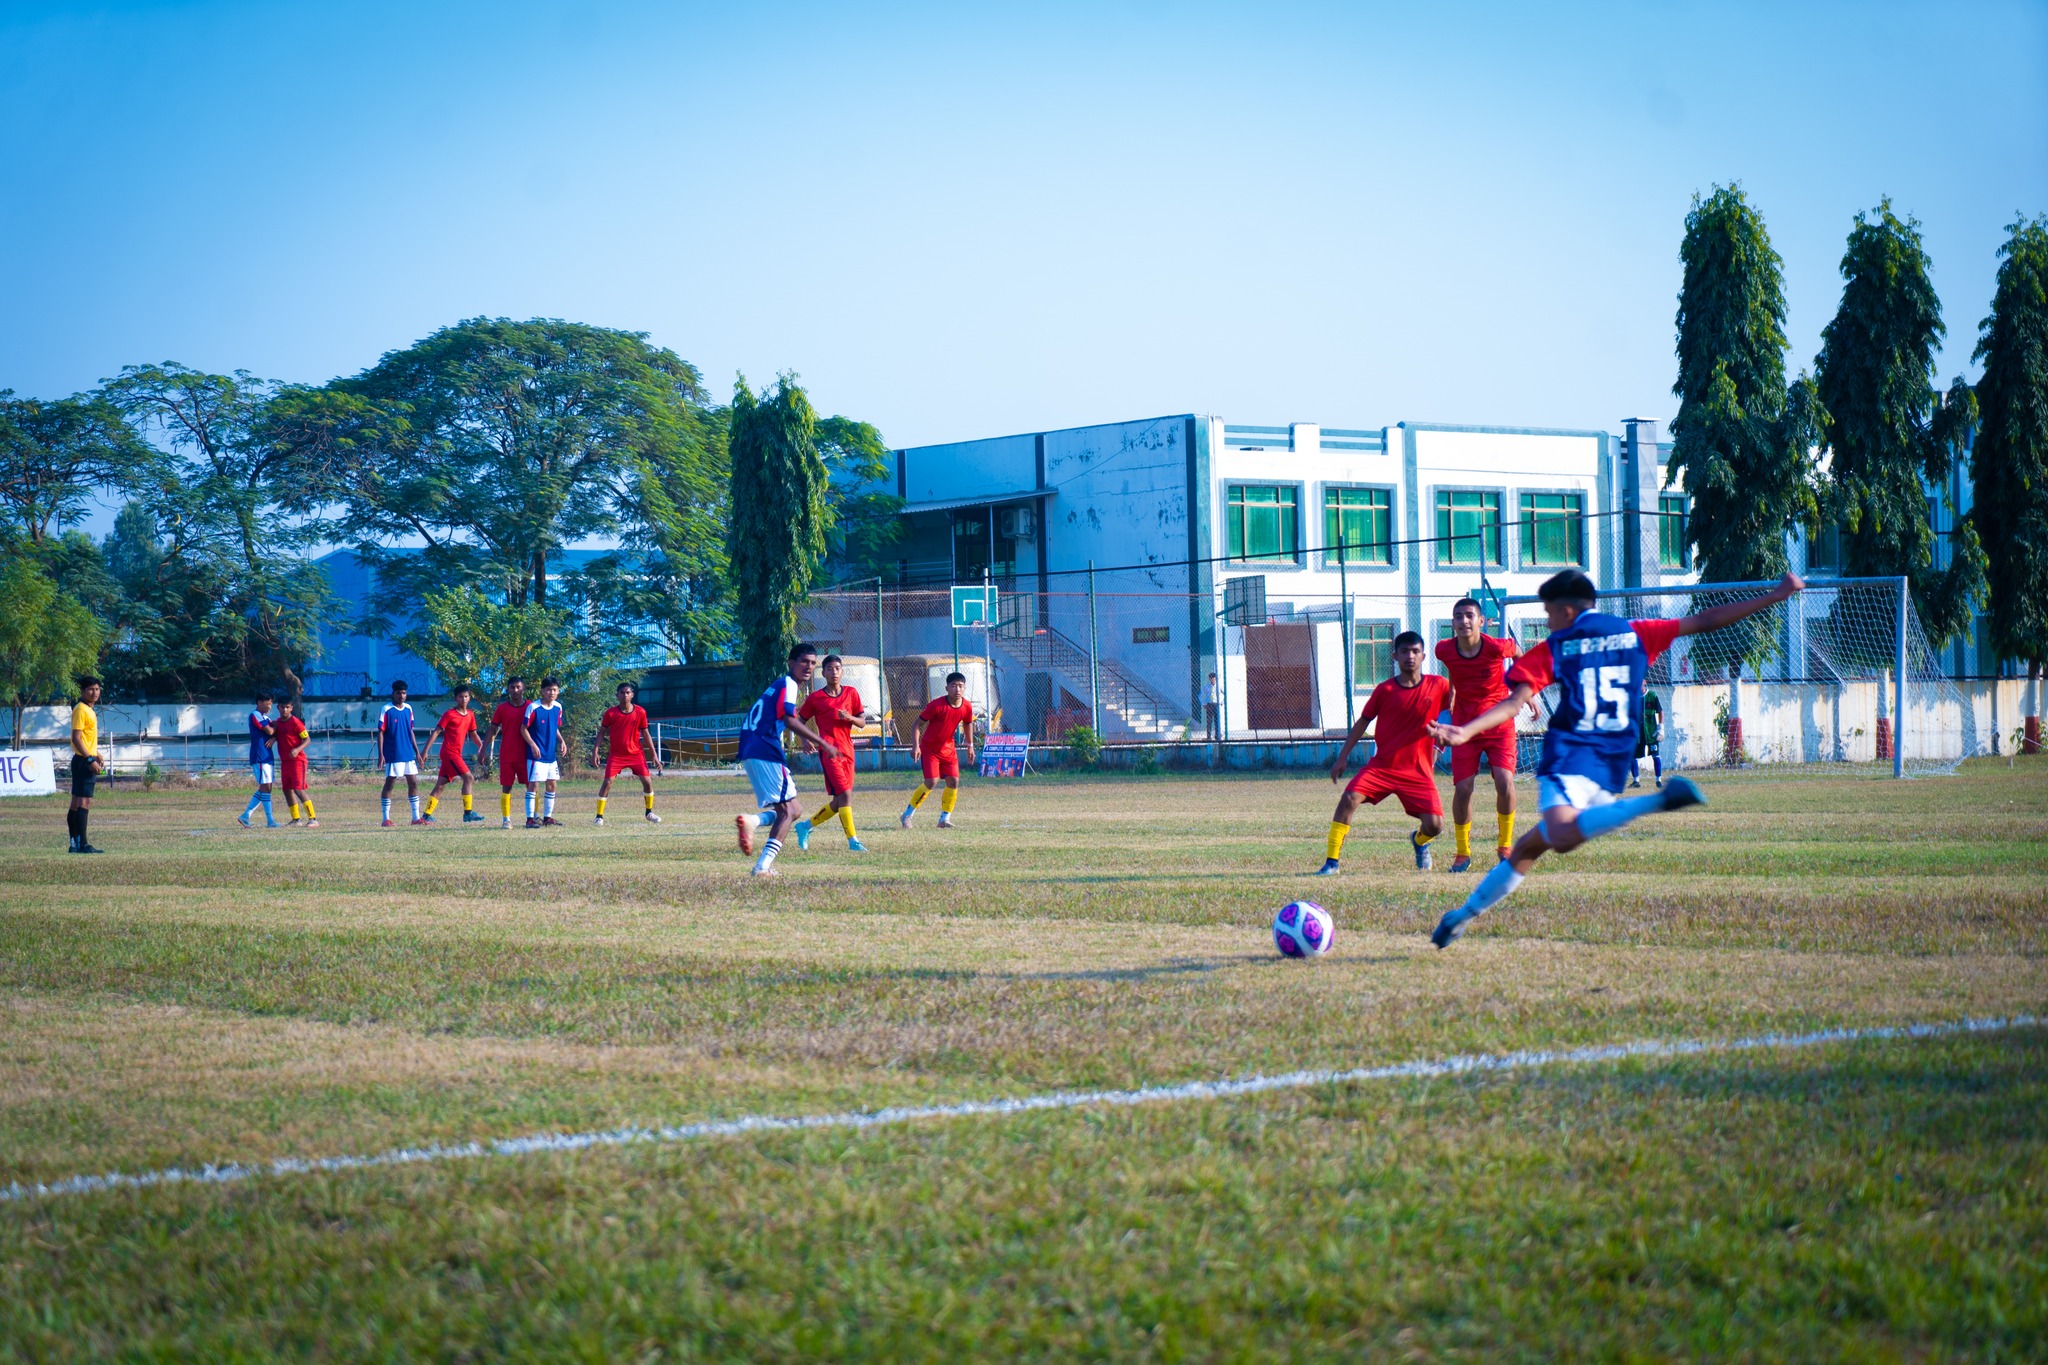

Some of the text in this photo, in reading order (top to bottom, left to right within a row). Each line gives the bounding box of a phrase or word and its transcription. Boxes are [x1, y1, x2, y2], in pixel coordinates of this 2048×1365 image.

[1576, 665, 1630, 731] 15
[685, 718, 716, 729] PUBLIC
[985, 734, 1015, 745] CHAMPIONS
